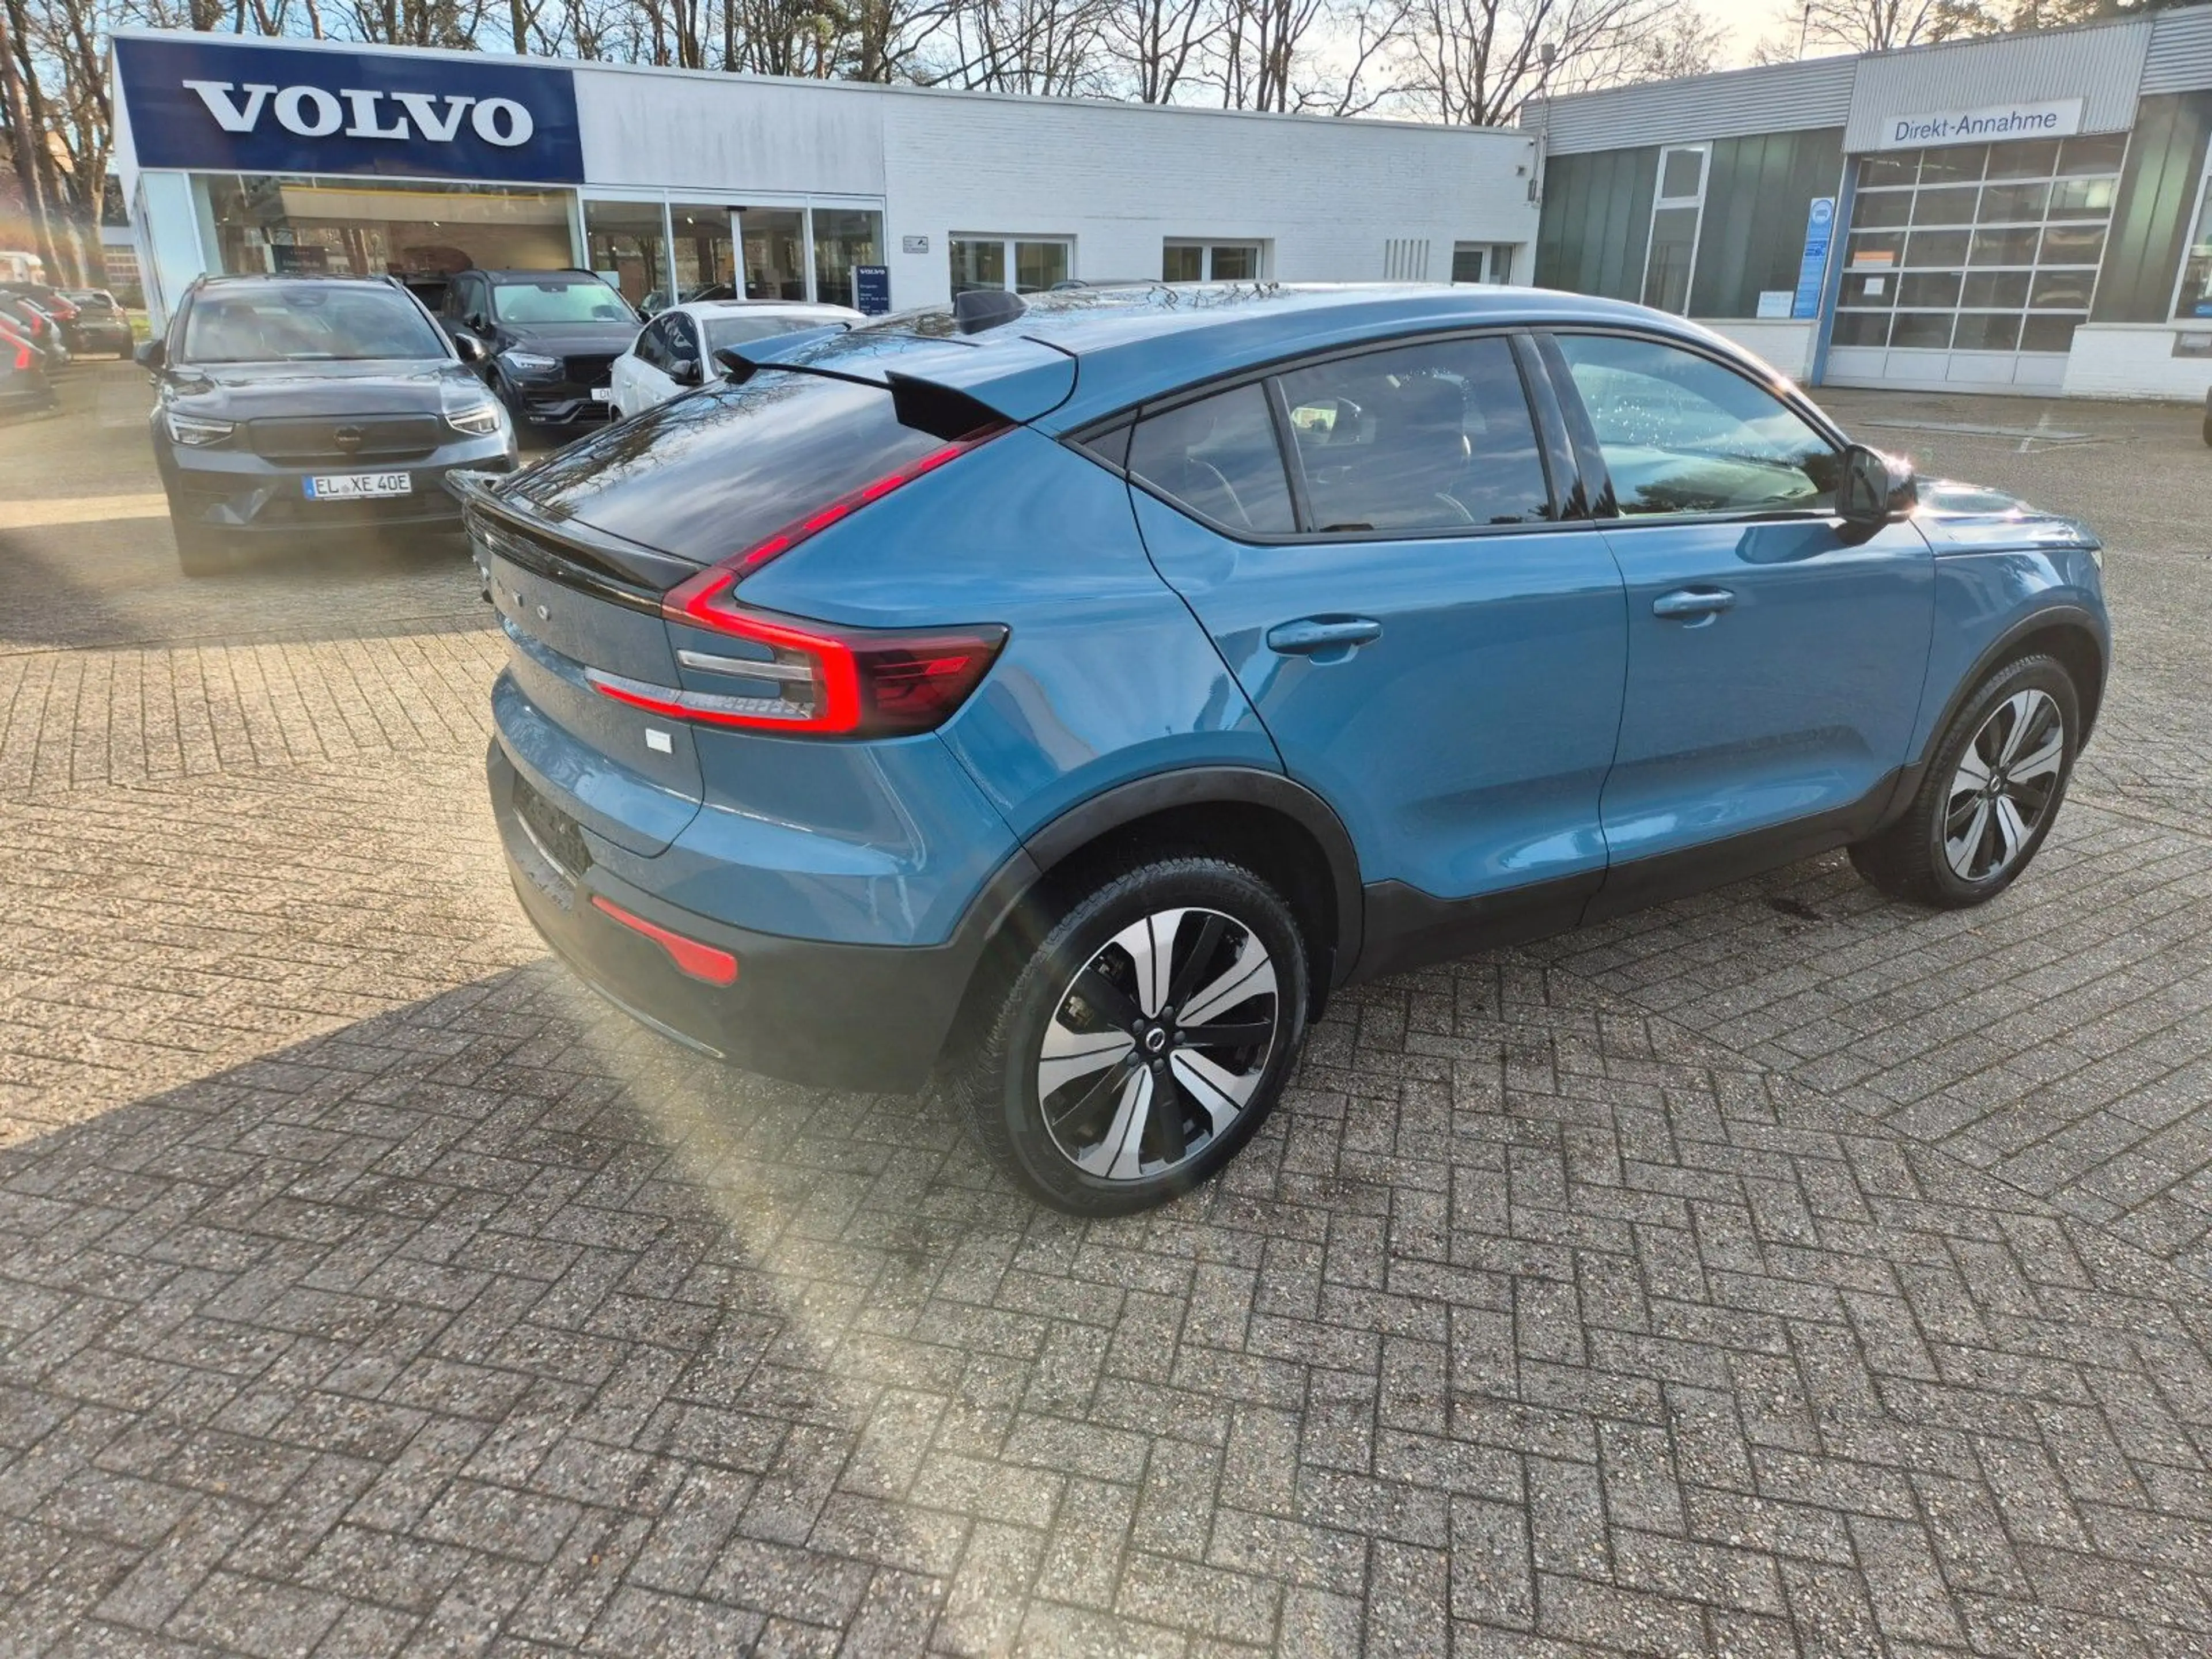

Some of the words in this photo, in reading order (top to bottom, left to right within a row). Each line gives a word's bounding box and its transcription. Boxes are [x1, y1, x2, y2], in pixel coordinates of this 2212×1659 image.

[183, 80, 533, 146] VOLVO
[1896, 111, 2057, 141] Direkt-Annahme
[316, 479, 339, 494] EL
[350, 477, 373, 492] XE
[377, 475, 408, 490] 40E
